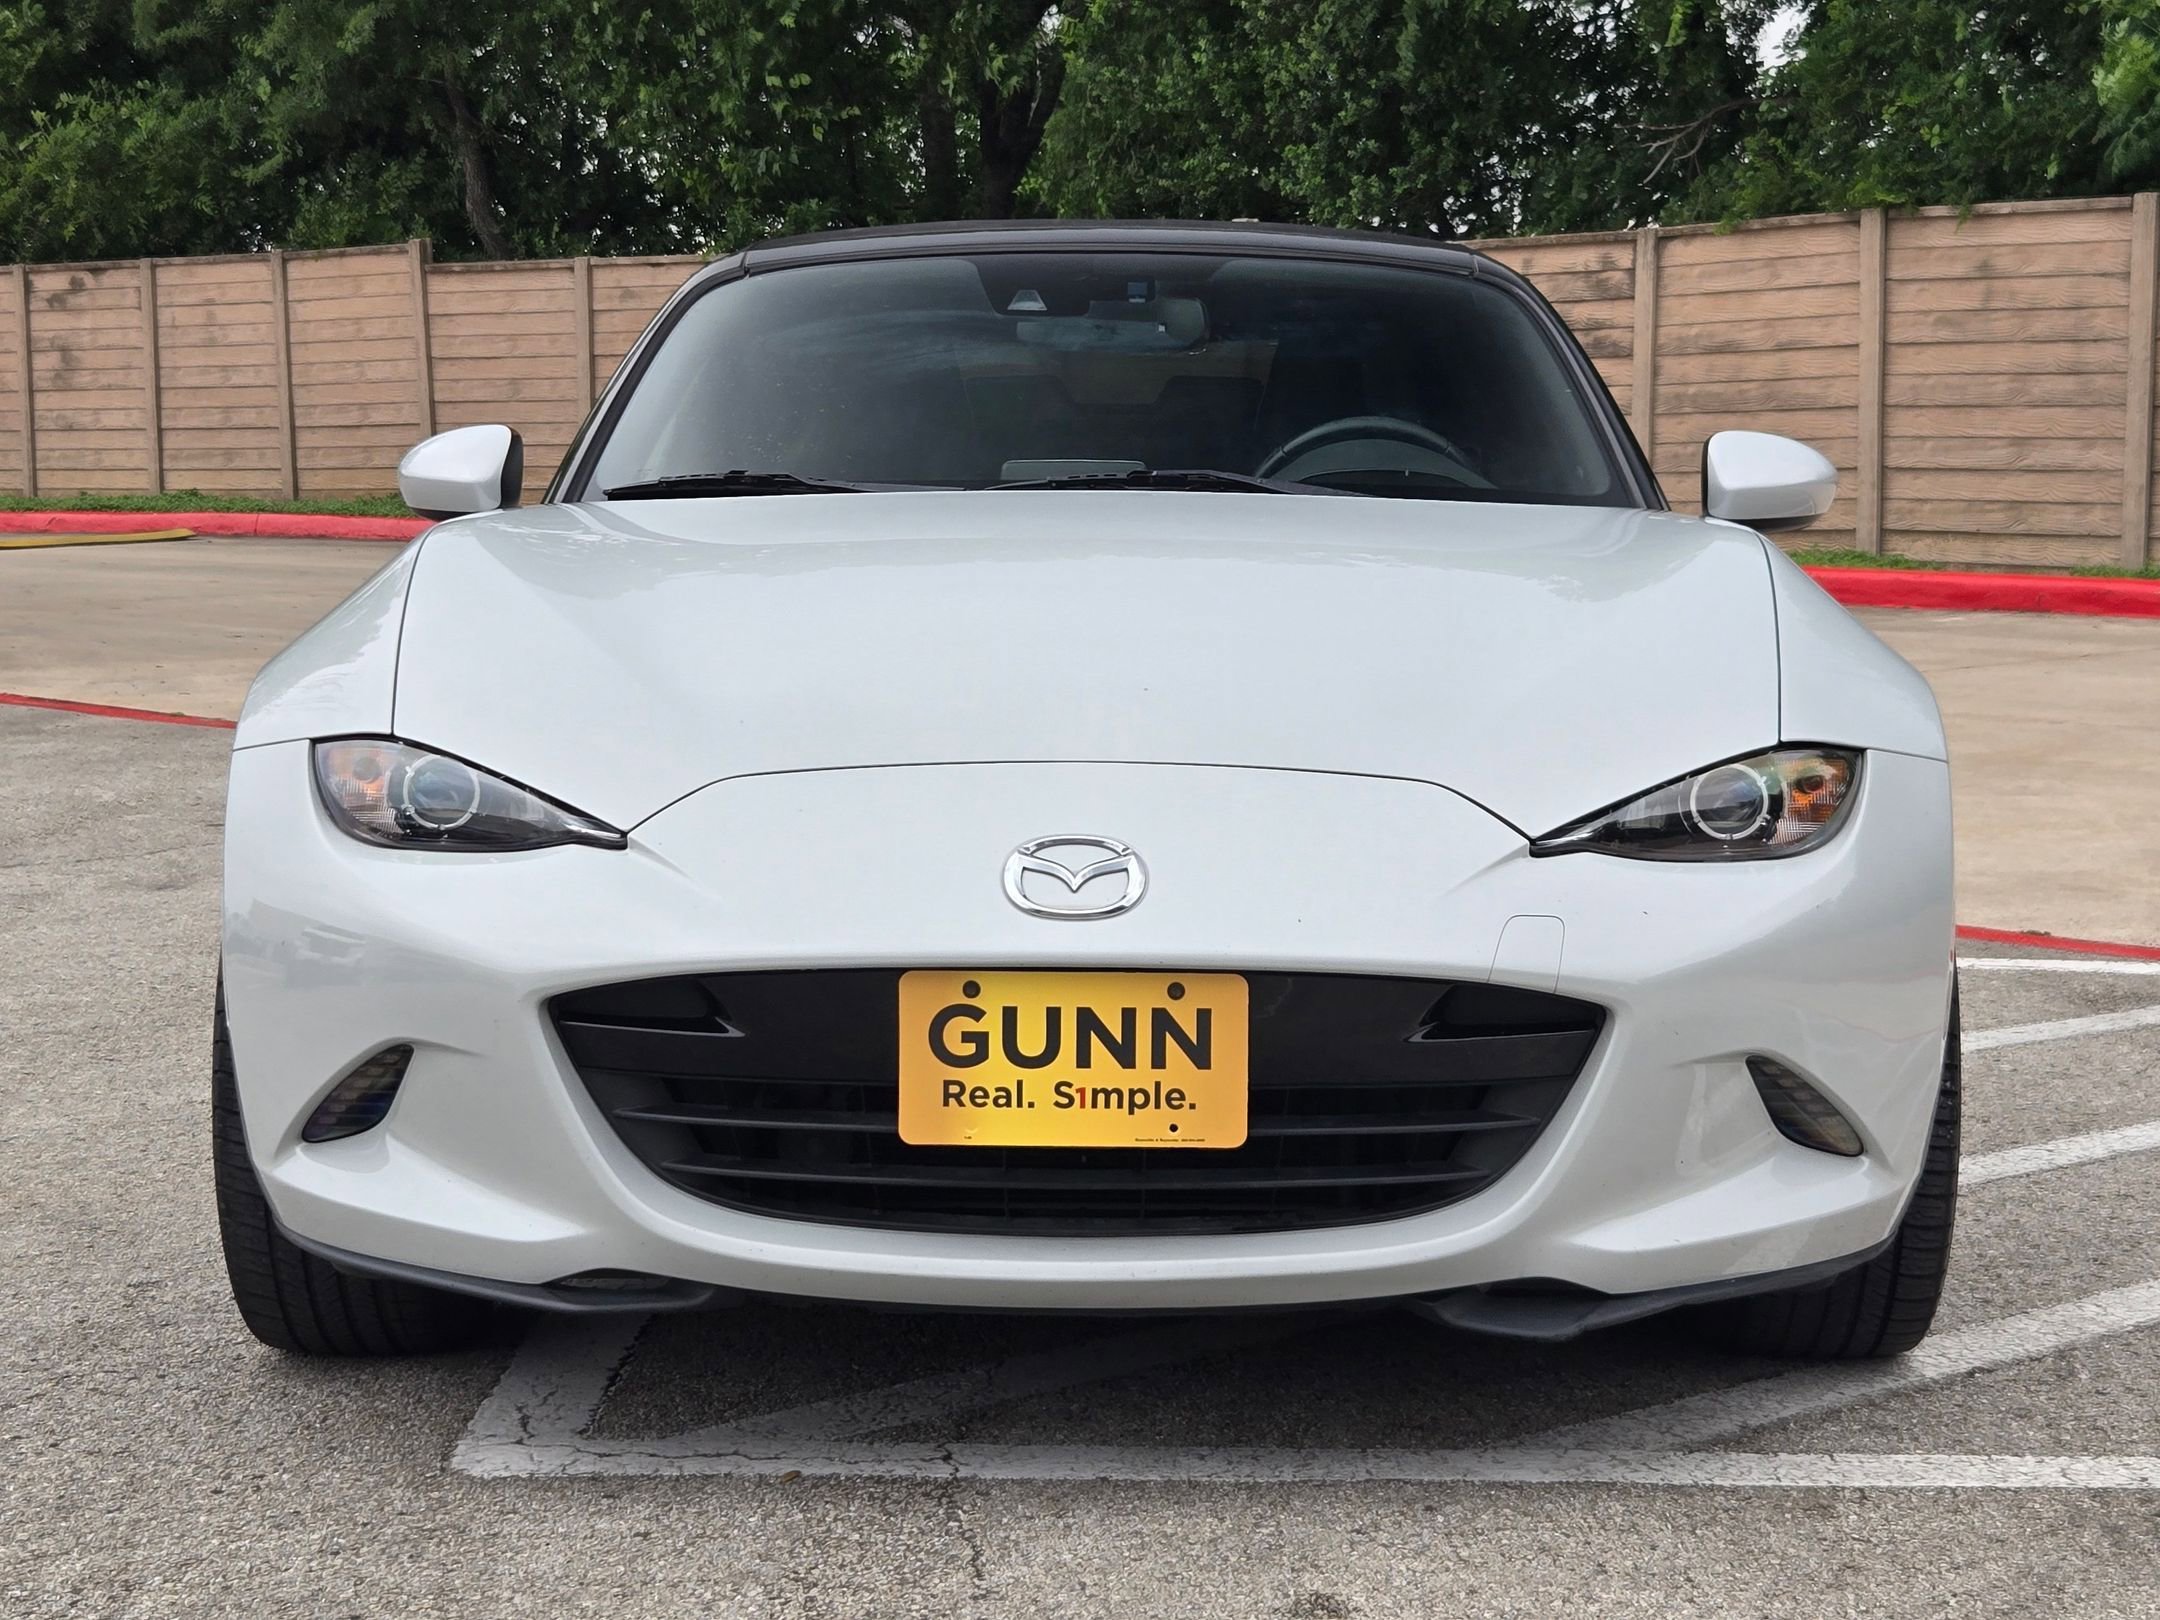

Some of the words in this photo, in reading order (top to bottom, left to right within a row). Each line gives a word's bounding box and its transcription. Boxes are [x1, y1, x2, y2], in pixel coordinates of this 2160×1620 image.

[928, 1003, 1212, 1070] GUNN
[942, 1079, 1035, 1108] Real.
[1053, 1081, 1197, 1115] S1mple.
